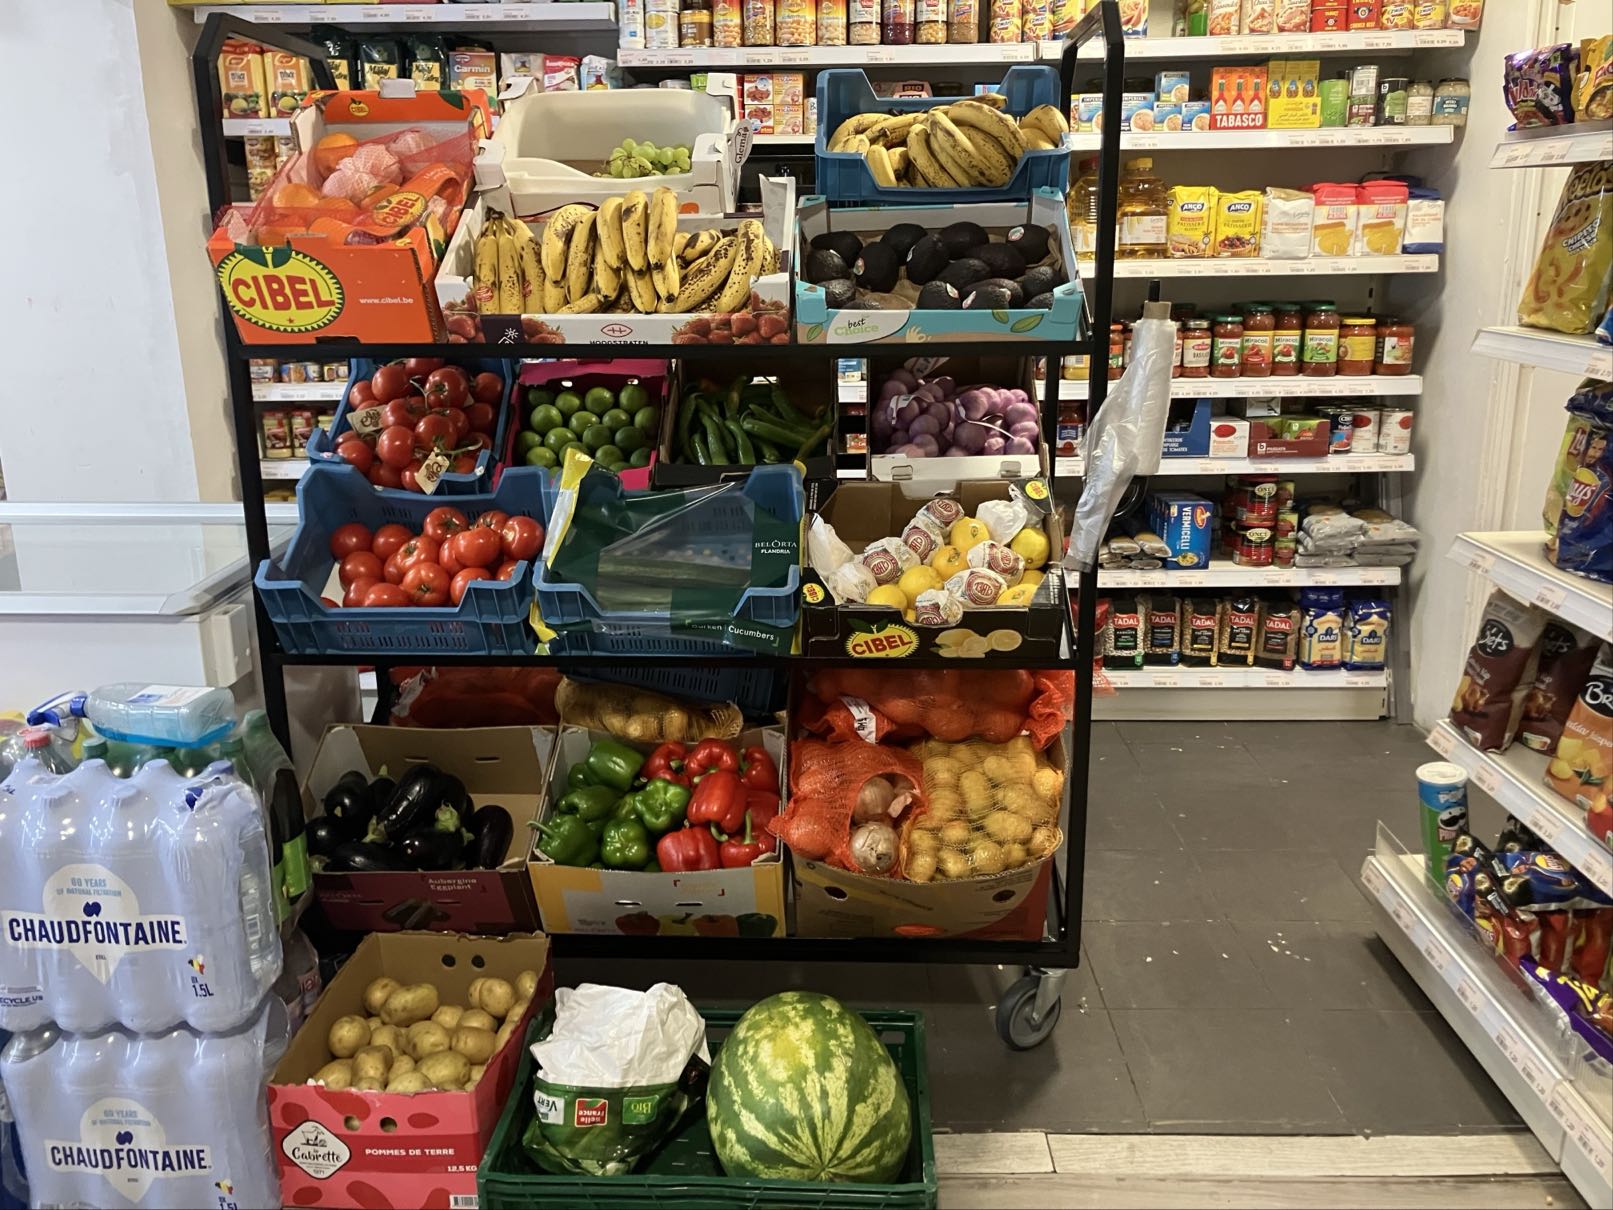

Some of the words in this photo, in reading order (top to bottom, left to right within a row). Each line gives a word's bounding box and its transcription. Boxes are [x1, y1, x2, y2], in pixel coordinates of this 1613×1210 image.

[454, 64, 491, 73] Carmin
[1216, 114, 1262, 128] TABASCO
[383, 196, 421, 226] CIBEL
[232, 274, 336, 311] CIBEL
[848, 317, 866, 329] best
[834, 325, 880, 337] Choice
[1181, 506, 1192, 550] VERMICELLI
[805, 584, 818, 602] CIBEL
[1114, 618, 1139, 626] TADAL
[1151, 615, 1176, 624] TADAL
[1231, 615, 1255, 625] TADAL
[1266, 620, 1291, 630] TADAL
[728, 624, 775, 641] Cucumbers
[1320, 634, 1338, 642] DARI
[851, 633, 914, 657] CIBEL
[84, 878, 107, 887] YEARS
[430, 883, 472, 891] Eggplant
[66, 888, 92, 896] NATURAL
[8, 917, 183, 946] CHAUDFONTAINE
[537, 1096, 558, 1113] VERT
[115, 1110, 138, 1119] YEARS
[291, 1146, 342, 1164] Cabrette
[365, 1148, 406, 1156] POMMES
[409, 1148, 422, 1156] DE
[424, 1148, 455, 1156] TERRE
[50, 1146, 207, 1172] CHAUDFONTAINE
